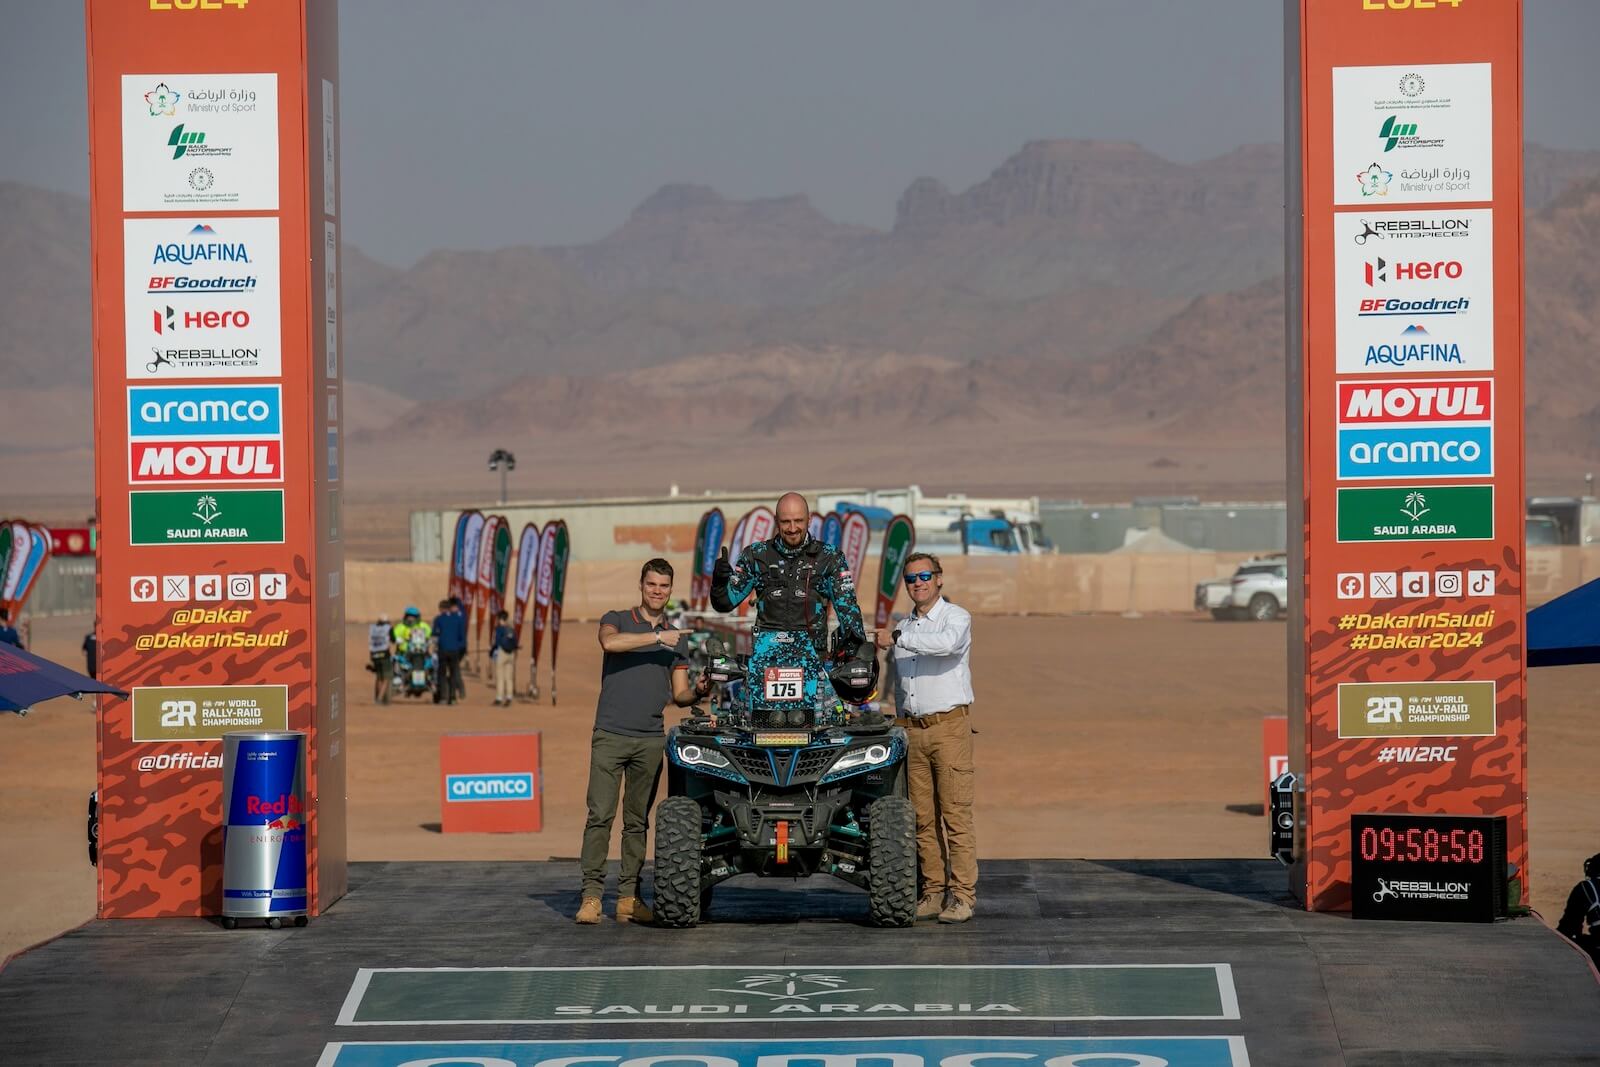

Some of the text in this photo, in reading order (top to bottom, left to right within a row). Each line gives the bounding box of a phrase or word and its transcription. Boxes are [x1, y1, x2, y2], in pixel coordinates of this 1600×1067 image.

[188, 103, 256, 112] Ministry of Sport
[1400, 182, 1470, 192] Ministry of Sport
[153, 243, 248, 265] AQUAFINA
[148, 276, 256, 289] BFGoodrich
[1360, 298, 1469, 312] BFGoodrich
[1365, 344, 1461, 366] AQUAFINA
[140, 400, 270, 422] aramco
[1346, 387, 1485, 418] MOTUL
[1350, 440, 1481, 463] aramco
[138, 446, 274, 476] MOTUL
[166, 528, 248, 538] SAUDI ARABIA
[1373, 524, 1456, 535] SAUDI ARABIA
[172, 608, 252, 626] @Dakar
[1338, 610, 1495, 630] #DakarInSaudi
[136, 630, 289, 650] @DakarInSaudi
[1350, 632, 1483, 650] #Dakar2024
[771, 683, 797, 698] 175
[1434, 696, 1464, 704] WORLD
[161, 700, 197, 727] 2R
[202, 708, 261, 718] RALLY-RAID
[1367, 697, 1403, 723] 2R
[1408, 704, 1468, 714] RALLY-RAID
[202, 718, 263, 726] CHAMPIONSHIP
[1408, 714, 1470, 722] CHAMPIONSHIP
[1377, 746, 1458, 763] #W2RC
[452, 779, 527, 795] aramco
[247, 794, 285, 815] Red
[1361, 827, 1483, 863] 09:58:58
[554, 1003, 1022, 1015] SAUDI ARABIA
